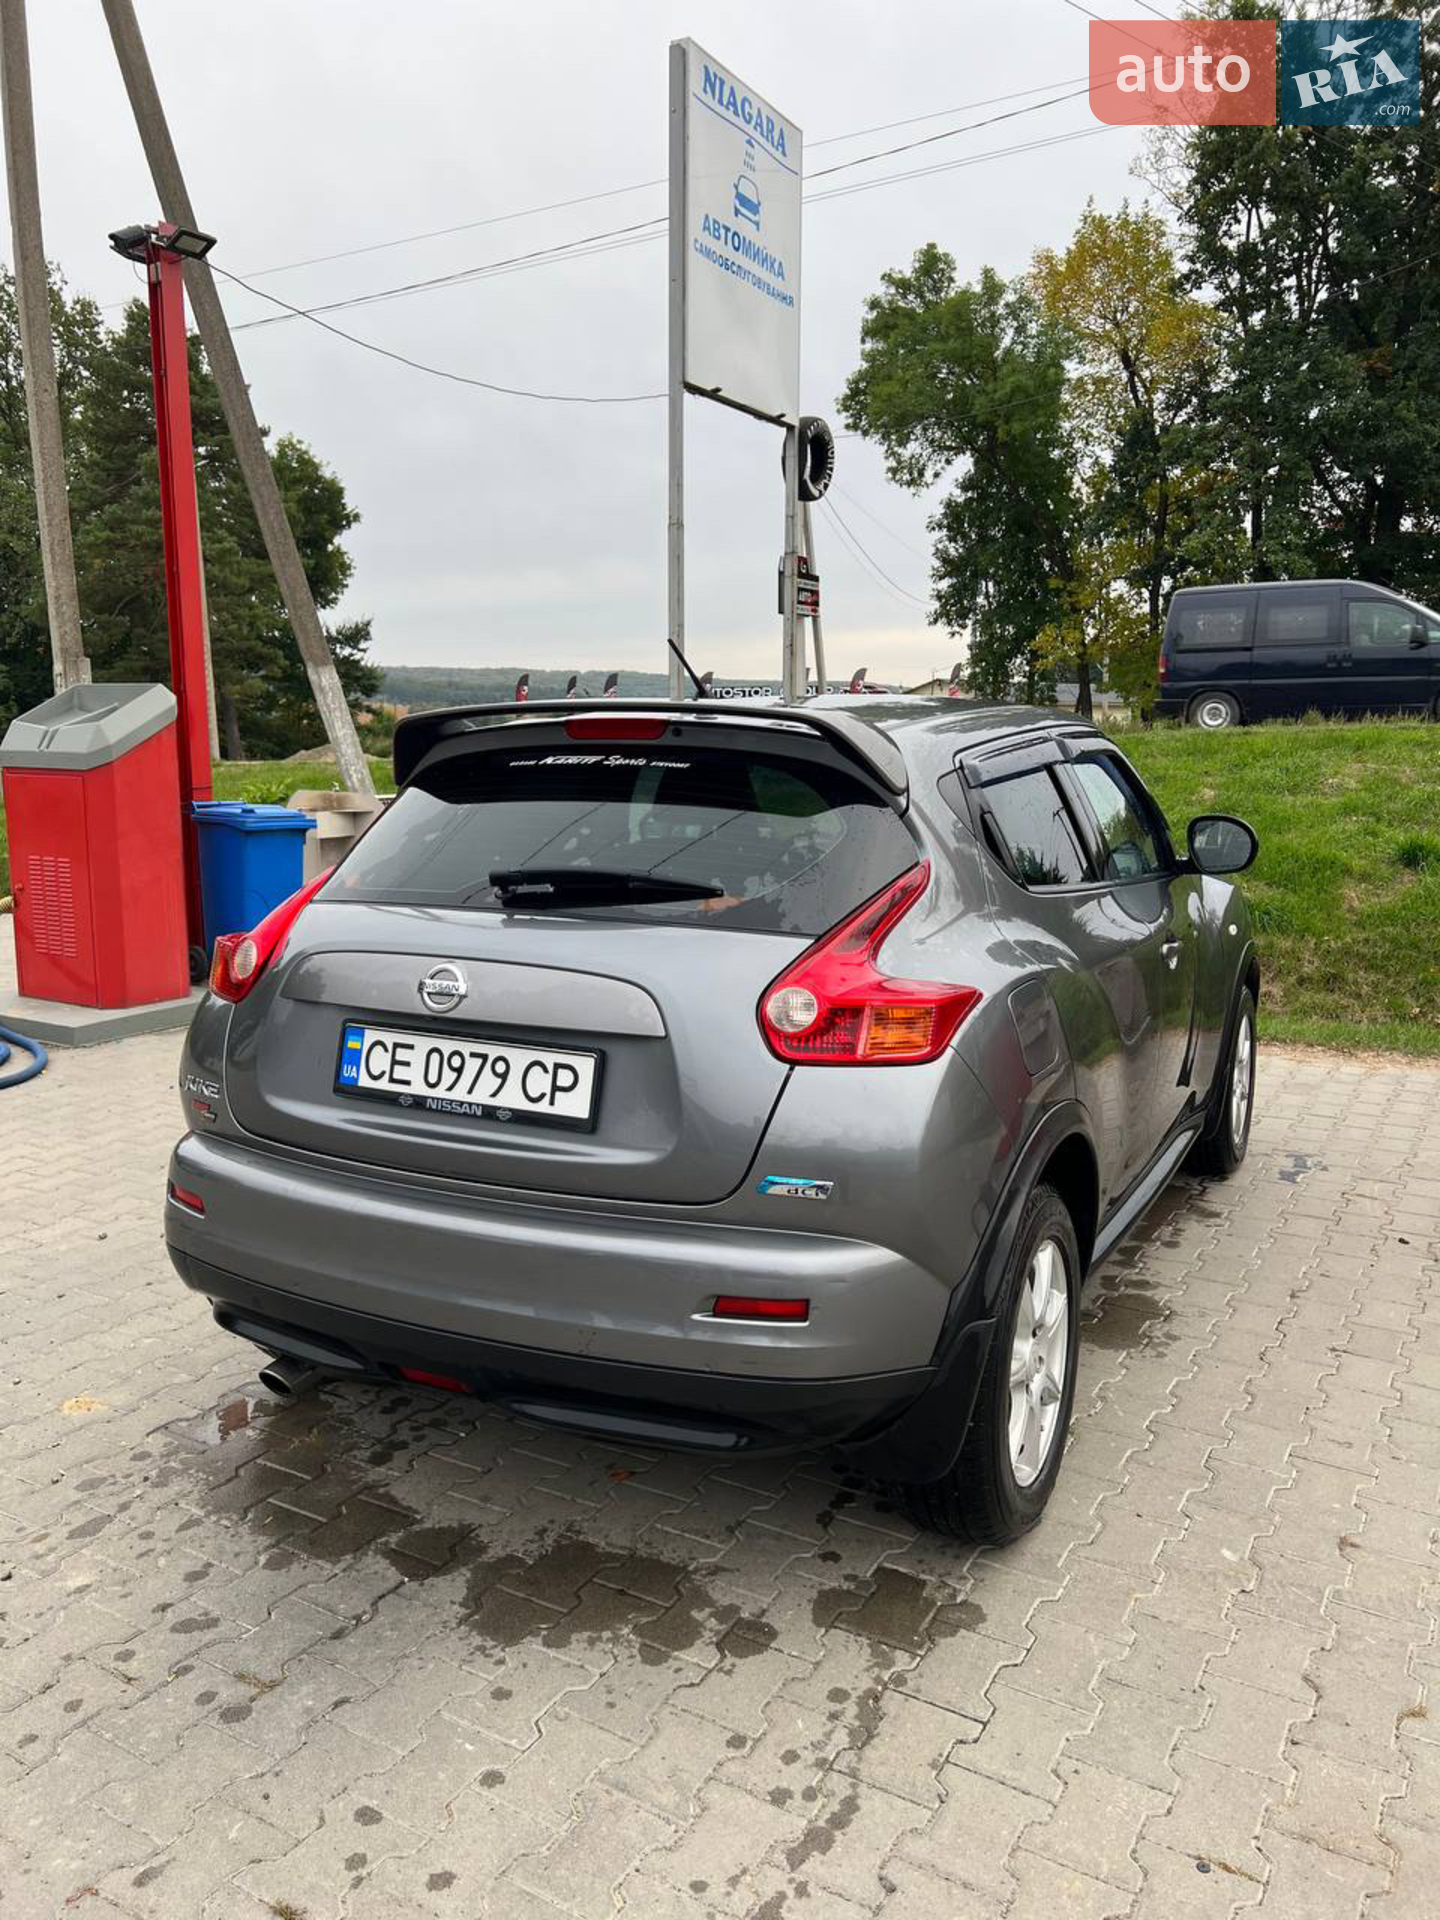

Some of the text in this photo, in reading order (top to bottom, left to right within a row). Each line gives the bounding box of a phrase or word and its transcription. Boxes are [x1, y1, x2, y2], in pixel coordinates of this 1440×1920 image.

[703, 64, 787, 158] NIAGARA
[693, 238, 794, 308] САМООБСЛУГОВУВАННЯ
[702, 213, 785, 281] АВТОМИЙКА
[342, 1064, 359, 1079] UA
[365, 1039, 580, 1107] CE 0979 CP
[425, 1097, 483, 1117] NISSAN
